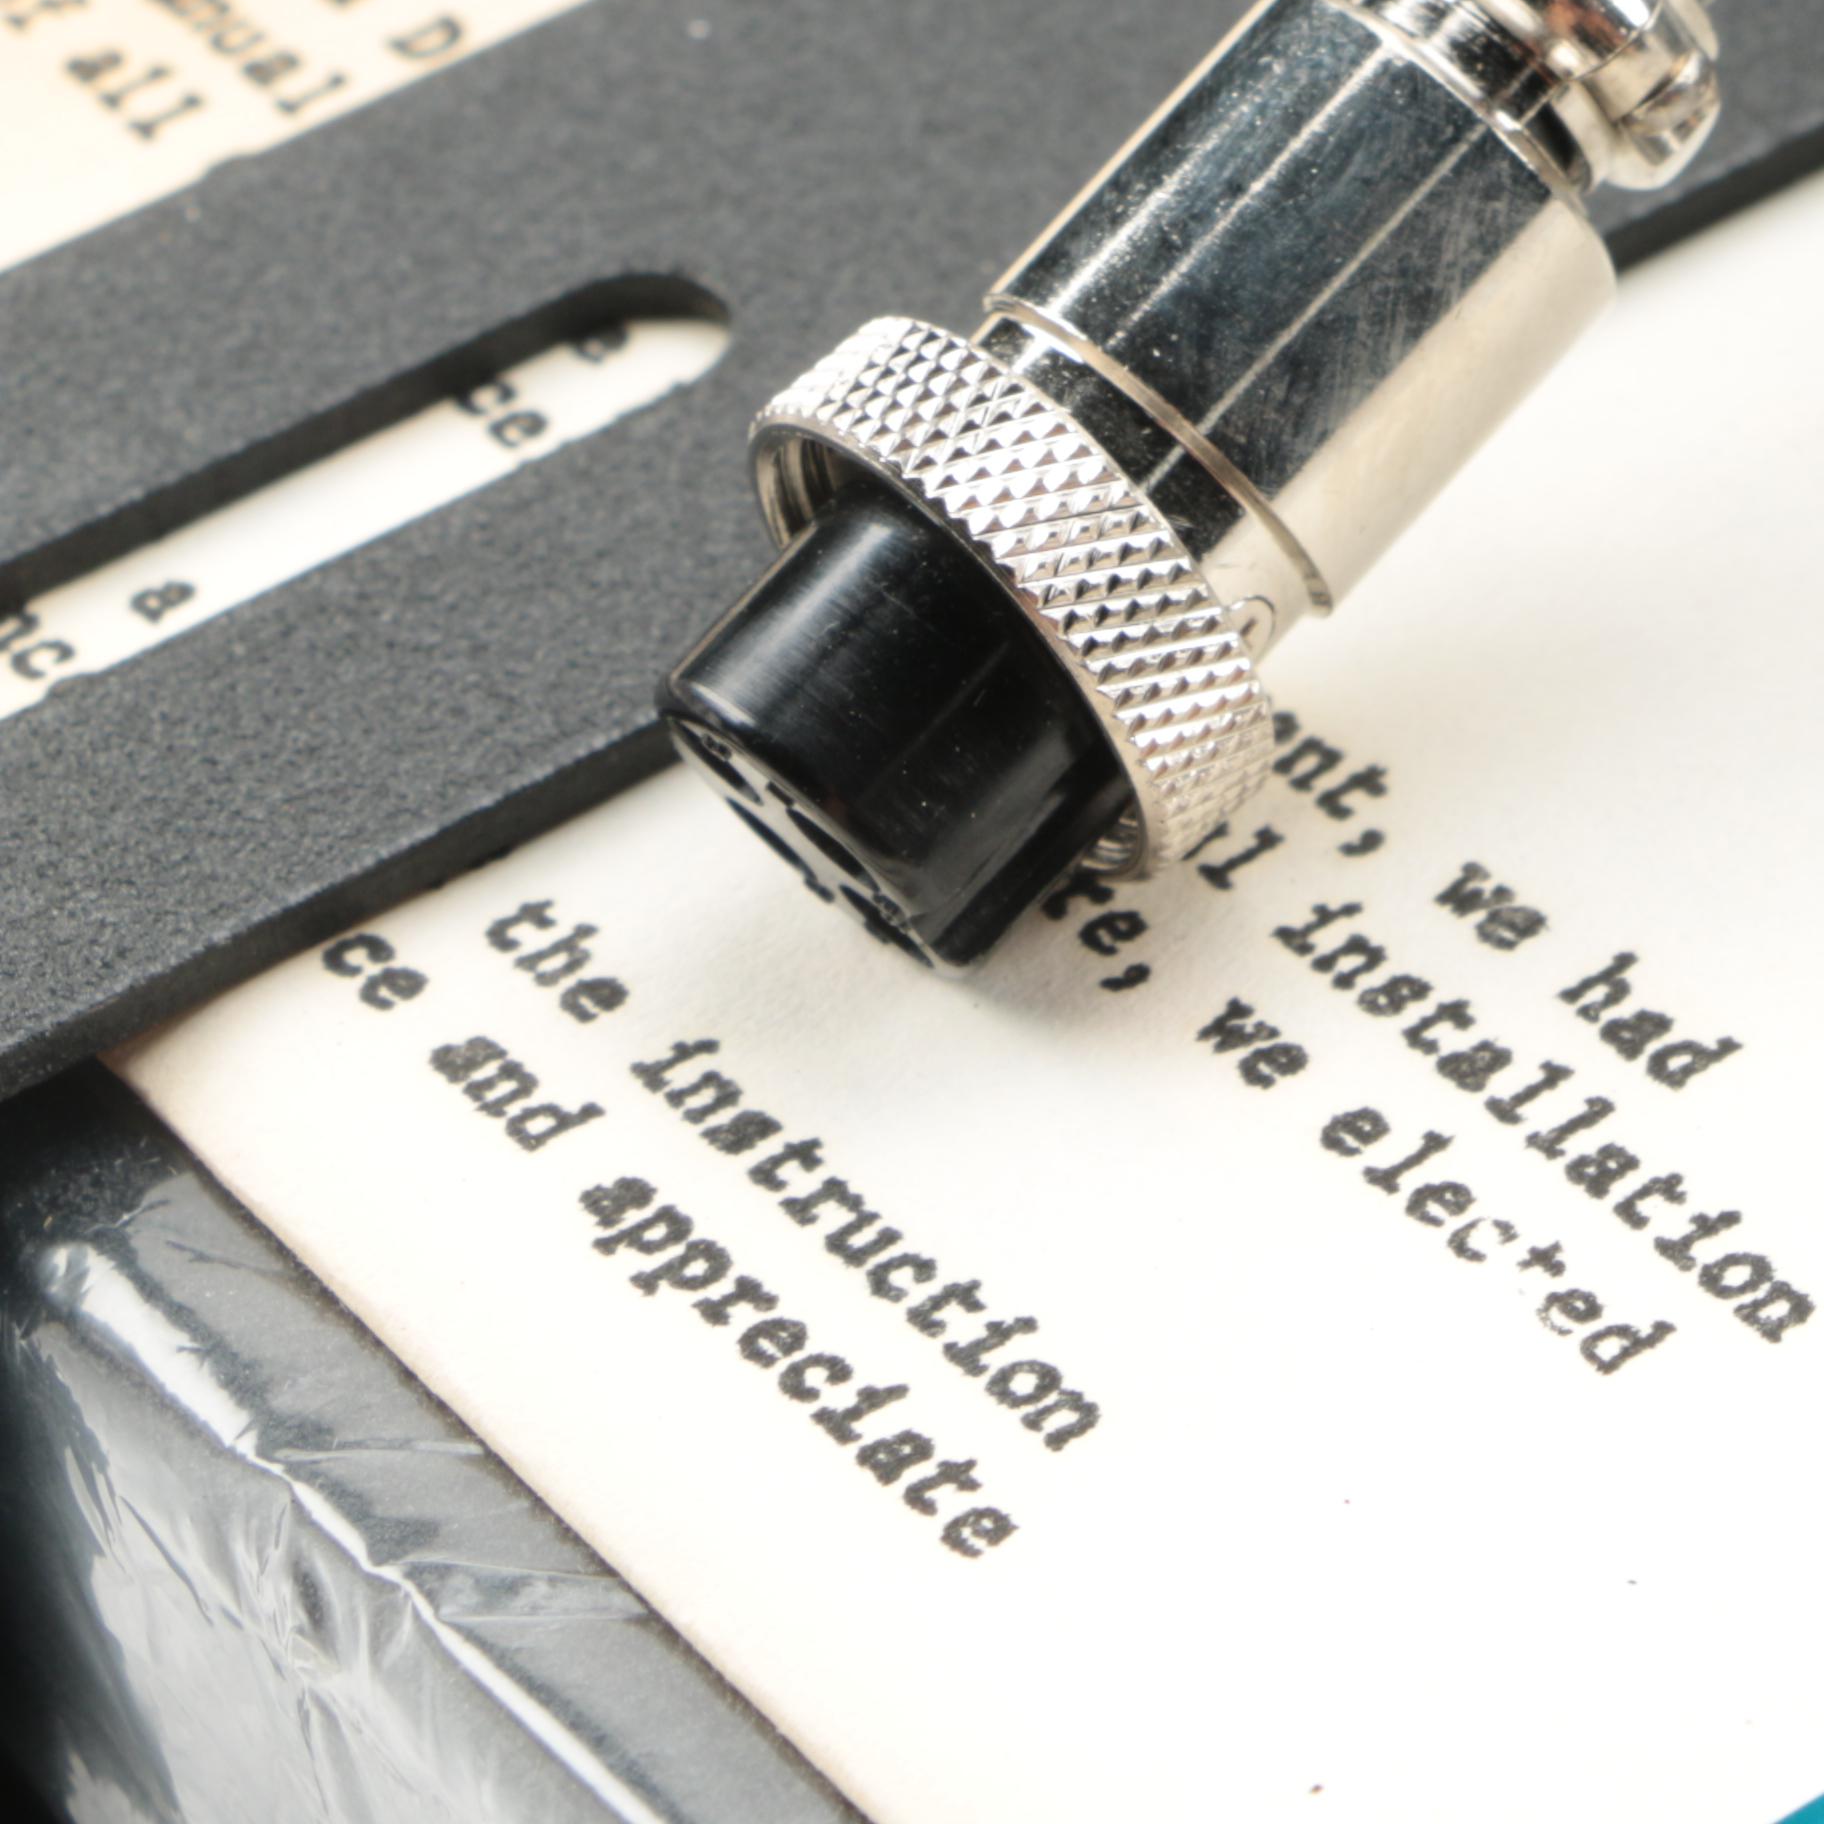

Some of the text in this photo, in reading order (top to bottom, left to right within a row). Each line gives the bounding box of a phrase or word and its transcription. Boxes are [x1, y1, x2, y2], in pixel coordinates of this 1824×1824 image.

[62, 47, 206, 143] all
[386, 14, 466, 62] D
[130, 582, 195, 624] a
[1272, 902, 1816, 1344] installation
[1434, 861, 1548, 951] we
[1558, 952, 1742, 1090] had
[321, 932, 1020, 1558] ce and appreciate
[486, 898, 1101, 1452] the instruction
[1197, 997, 1309, 1089] we
[1320, 1107, 1677, 1375] elected
